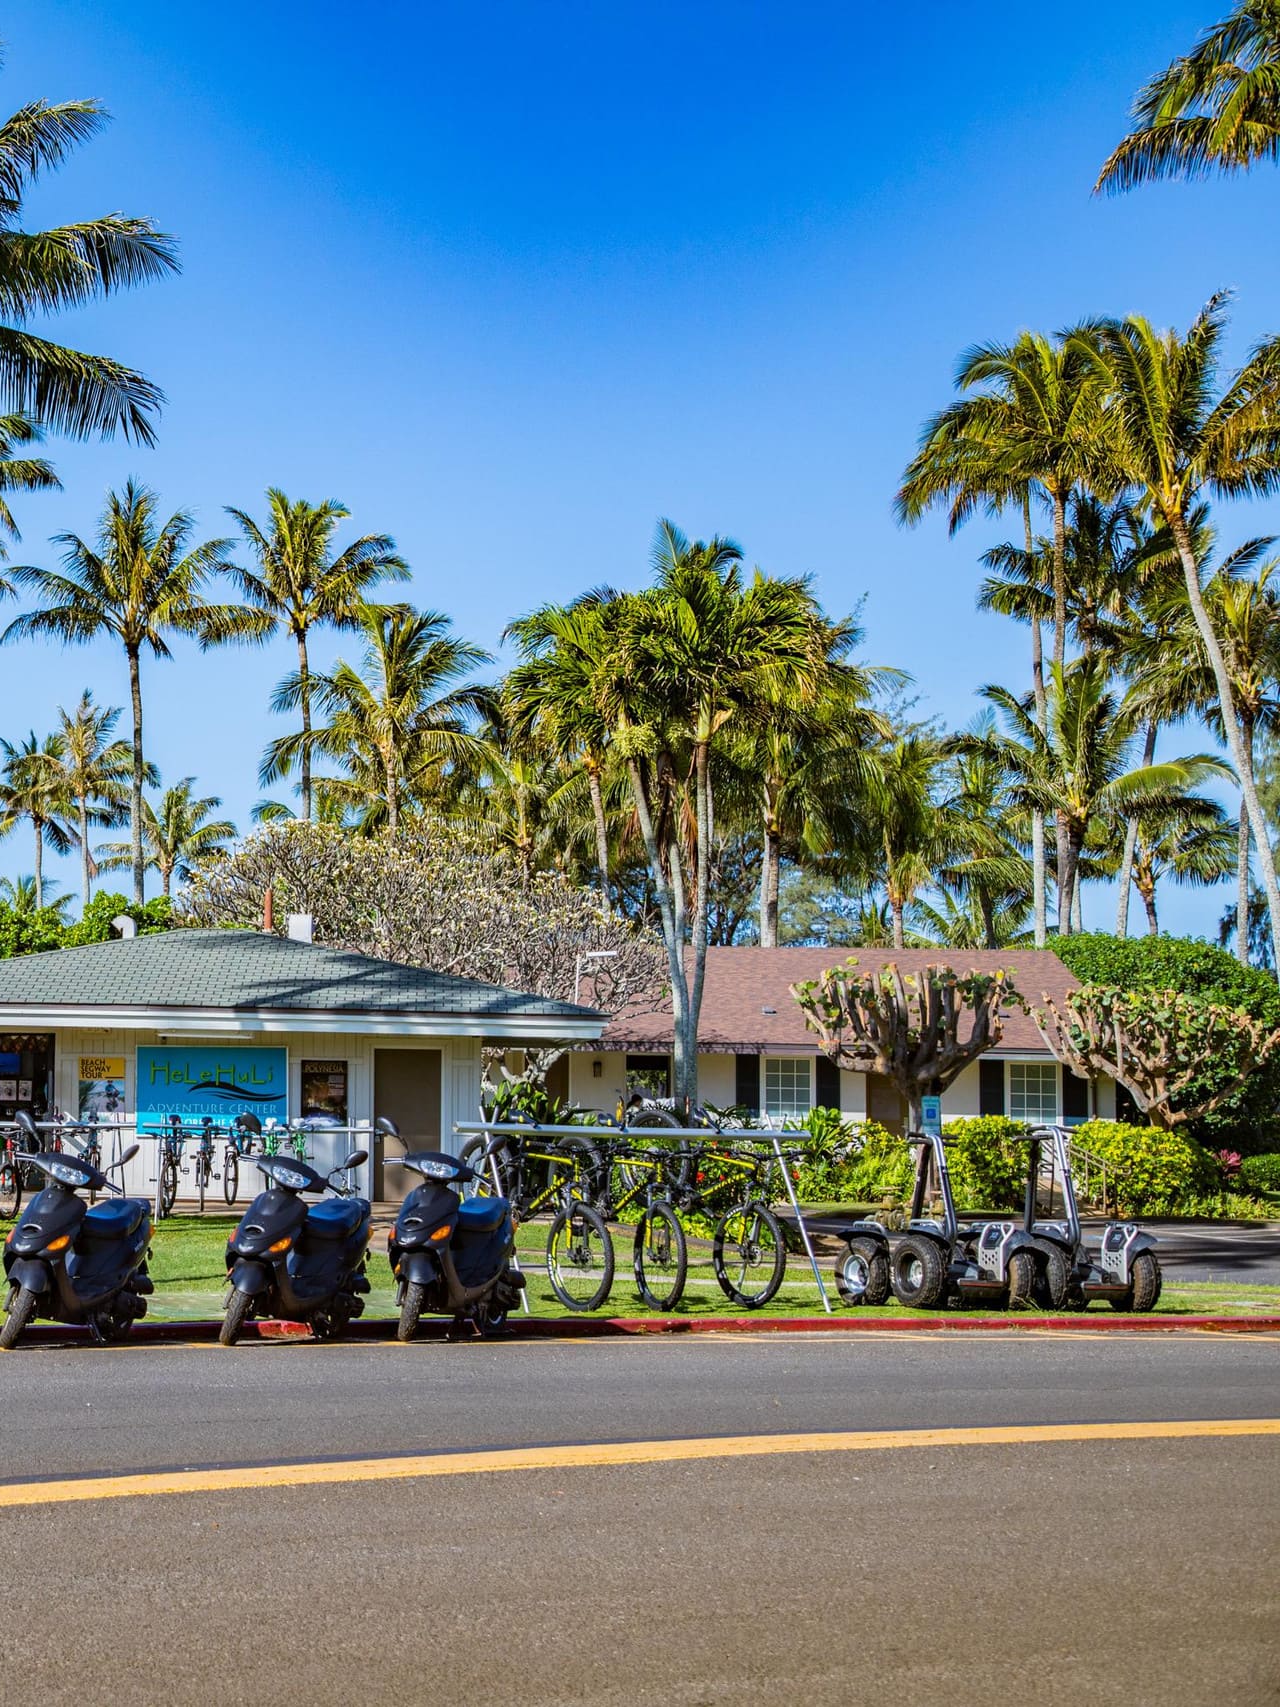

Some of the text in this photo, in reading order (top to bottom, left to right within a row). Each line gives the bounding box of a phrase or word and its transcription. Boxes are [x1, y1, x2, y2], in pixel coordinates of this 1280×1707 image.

[81, 1058, 106, 1066] BEACH
[81, 1065, 112, 1073] SEGWAY
[147, 1103, 278, 1115] ADVENTURE CENTER
